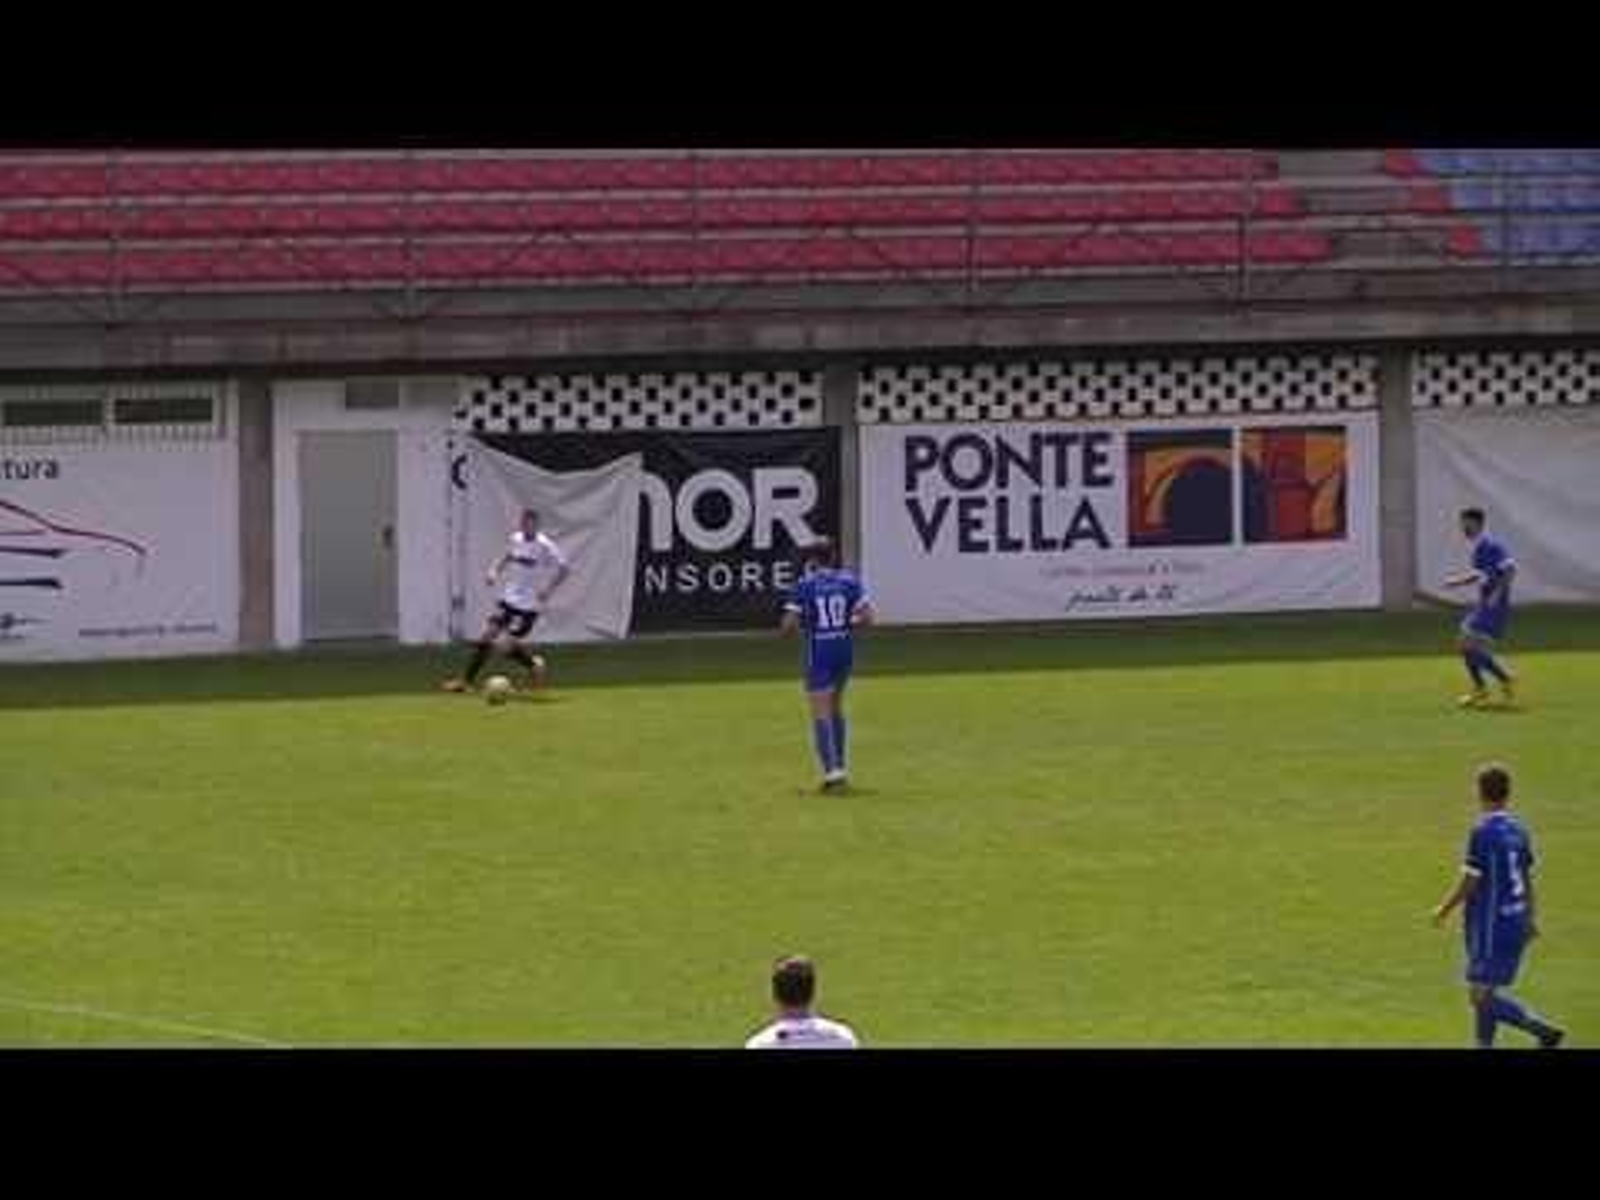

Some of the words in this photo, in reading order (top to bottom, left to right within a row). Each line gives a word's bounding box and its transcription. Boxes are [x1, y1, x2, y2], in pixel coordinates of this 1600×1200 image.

[905, 432, 1115, 492] PONTE
[905, 495, 1112, 553] VELLA
[644, 558, 808, 594] NSORE
[815, 594, 847, 629] 10
